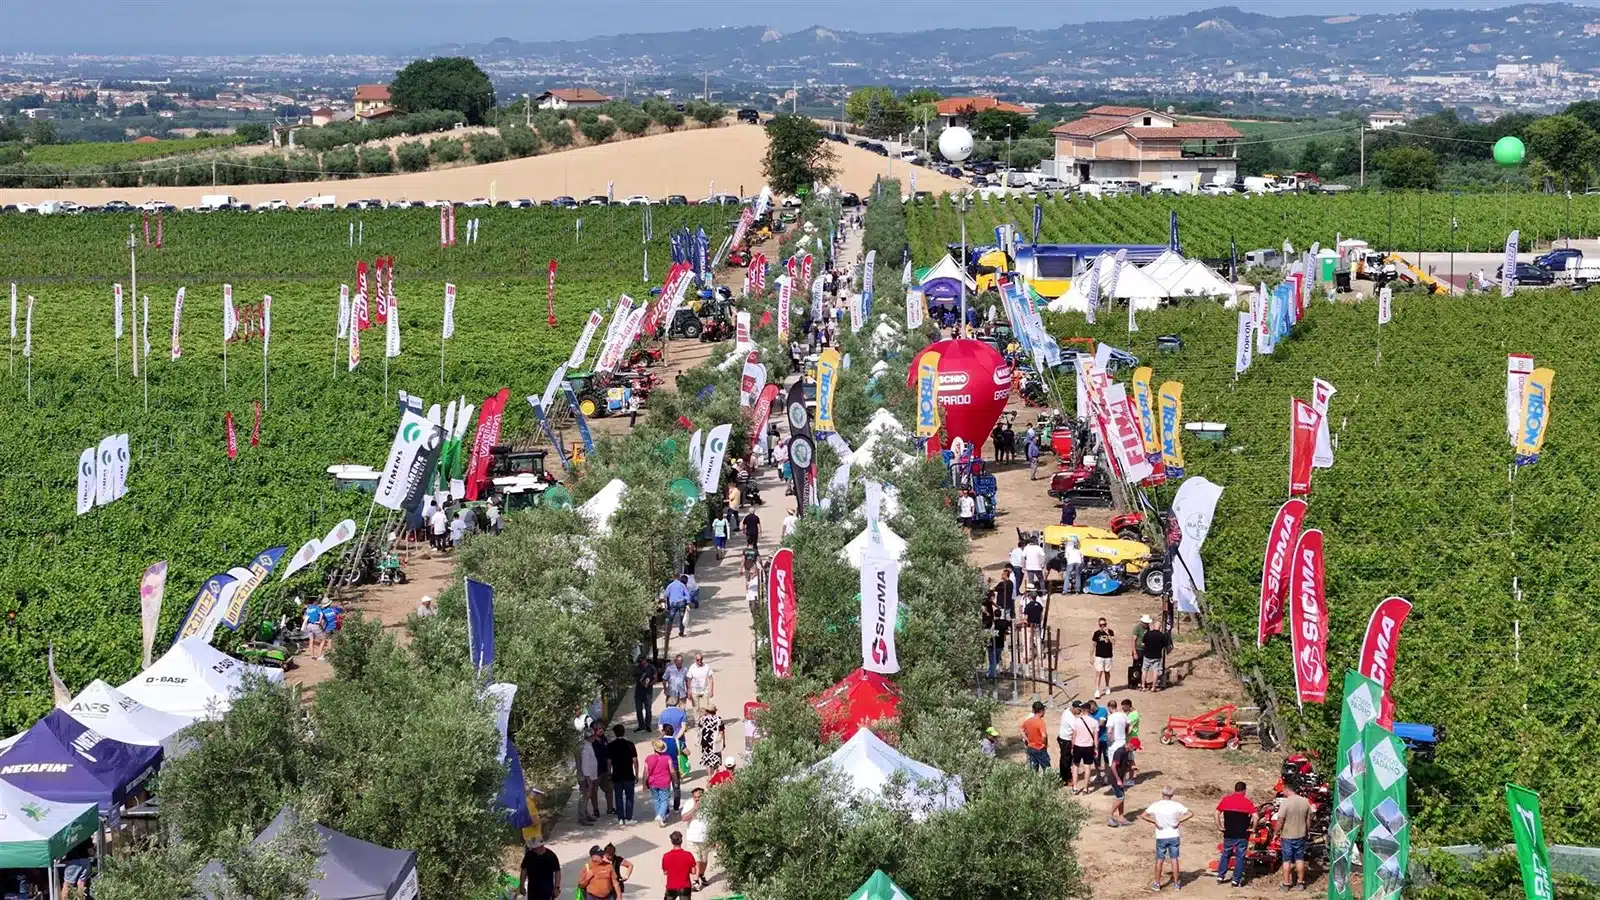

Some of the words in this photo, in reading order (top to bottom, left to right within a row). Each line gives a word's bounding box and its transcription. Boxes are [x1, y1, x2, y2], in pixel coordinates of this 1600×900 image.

[1523, 381, 1545, 447] NOBILI
[384, 450, 403, 496] CLEMENS
[1268, 513, 1295, 594] SICMA
[876, 570, 887, 636] SICMA
[1301, 549, 1317, 642] SICMA
[160, 676, 188, 684] BASF
[1370, 615, 1395, 687] CMA
[1, 763, 70, 775] NETAFIM
